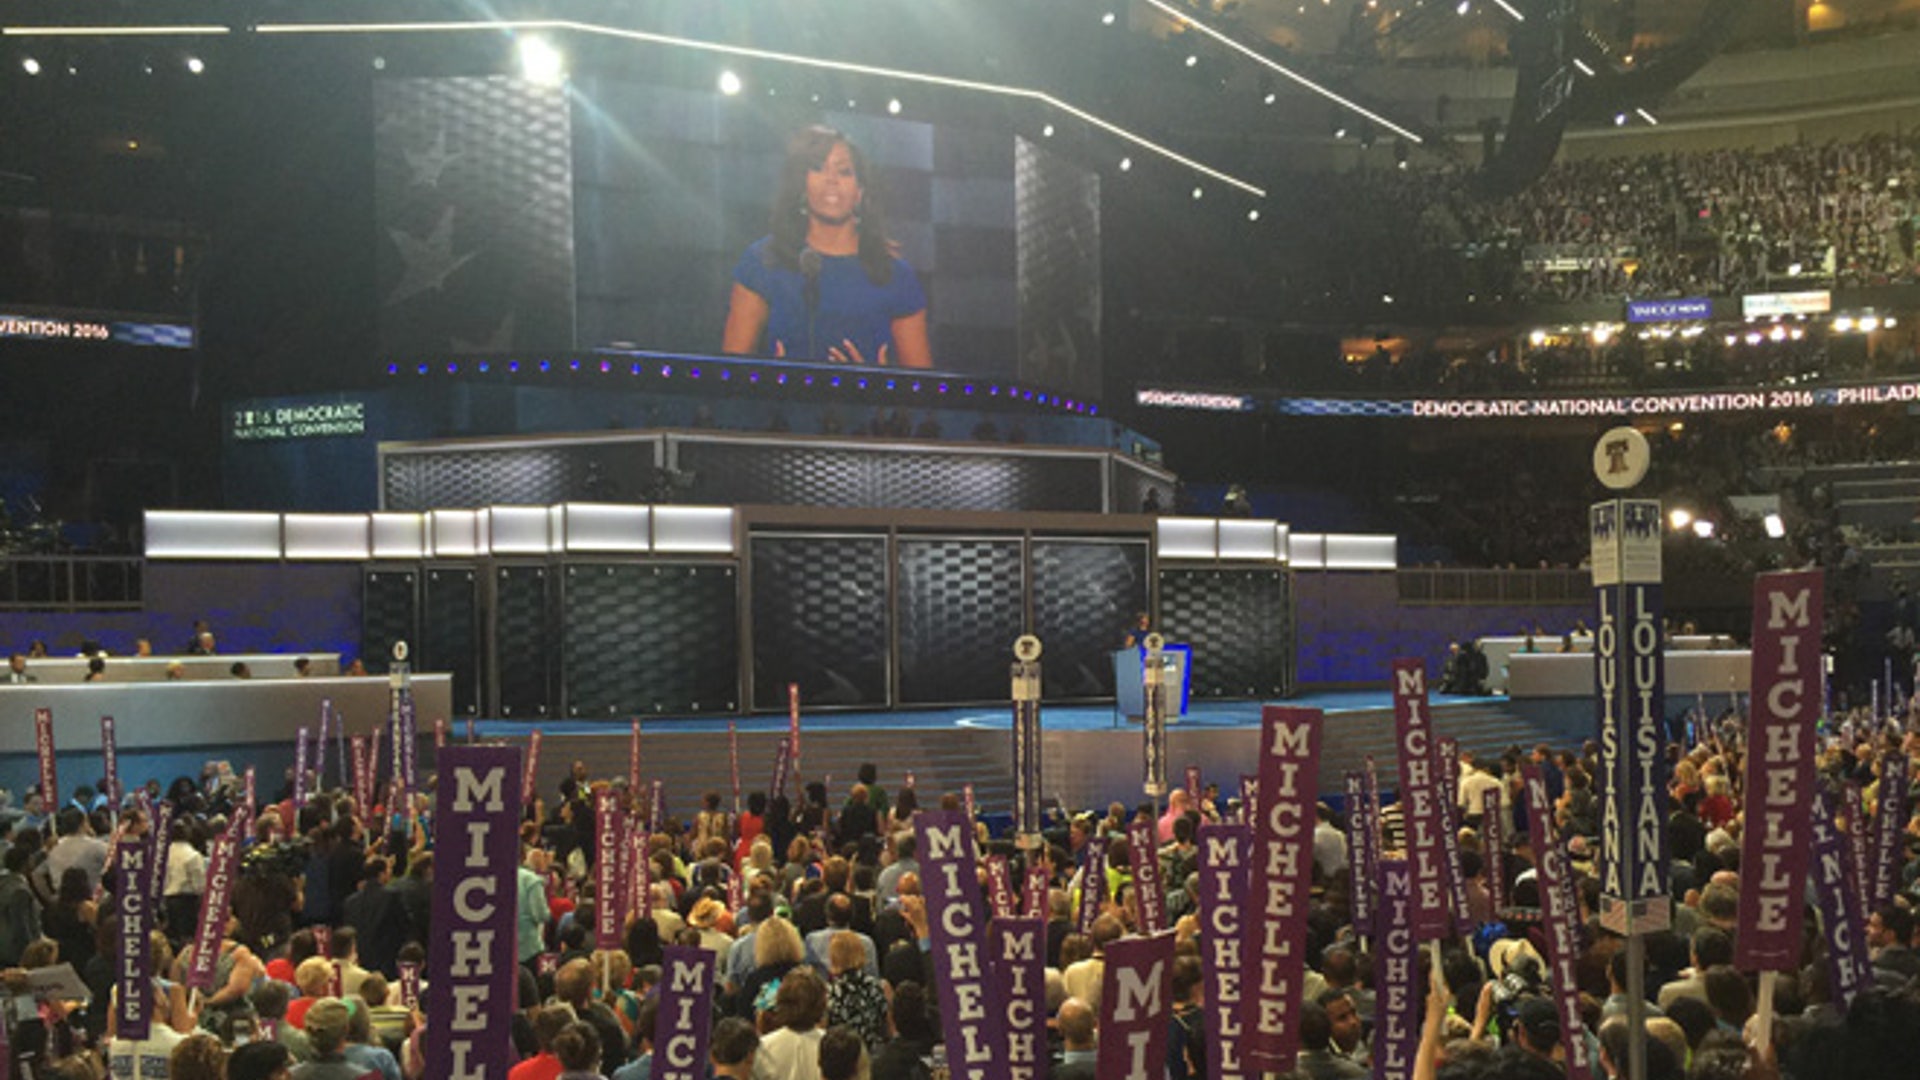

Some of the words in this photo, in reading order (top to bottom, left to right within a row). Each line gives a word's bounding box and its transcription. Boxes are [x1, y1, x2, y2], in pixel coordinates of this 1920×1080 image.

[1412, 399, 1529, 417] DEMOCRATIC
[1535, 397, 1628, 416] NATIONAL
[1630, 394, 1764, 413] CONVENTION
[1768, 391, 1813, 409] 2016
[1837, 384, 1920, 405] PHILAD
[1396, 668, 1440, 909] MICHELLE
[1598, 588, 1622, 897] LOUISIANA
[1633, 586, 1661, 896] LOUISIANA
[1756, 590, 1810, 931] MICHELLE
[196, 838, 236, 973] MICHELLE
[601, 796, 617, 934] MICHELLE
[1257, 721, 1310, 1035] MICHELLE
[1347, 779, 1366, 919] MICHELLE
[121, 850, 145, 1021] MICHELLE
[1207, 836, 1243, 1080] MICHELL
[664, 960, 704, 1080] MIC
[1113, 960, 1165, 1080] MI
